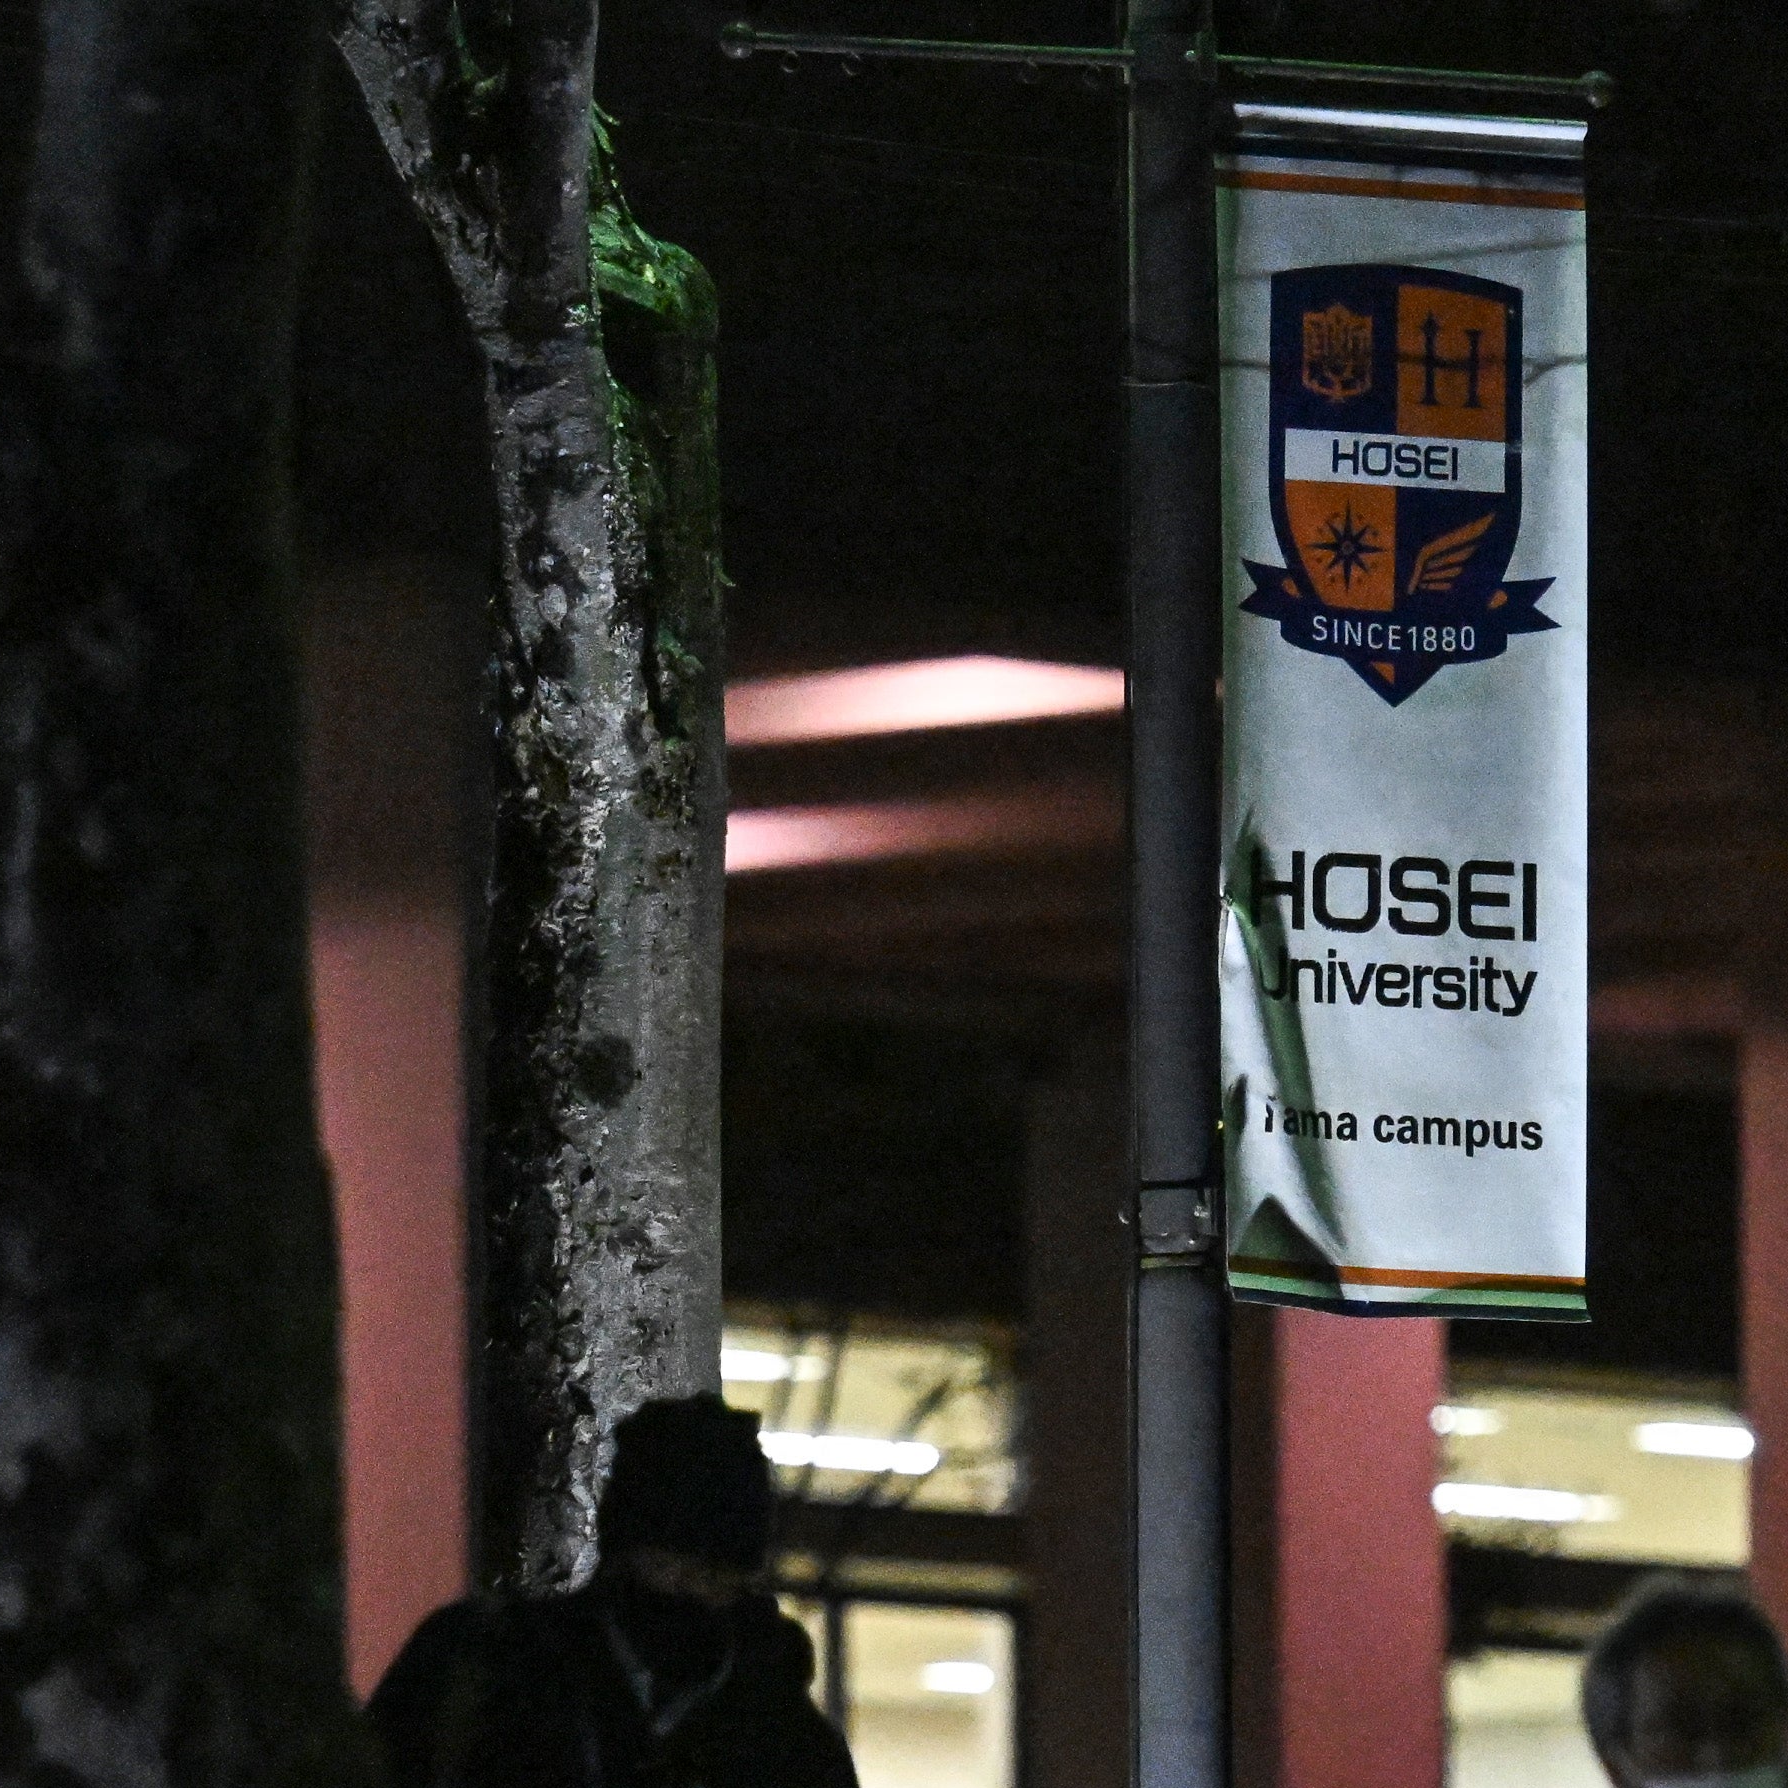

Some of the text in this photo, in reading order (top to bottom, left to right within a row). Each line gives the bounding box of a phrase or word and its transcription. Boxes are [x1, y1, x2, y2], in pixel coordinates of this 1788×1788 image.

[1331, 438, 1459, 481] HOSEI
[1251, 848, 1538, 942] HOSEI
[1257, 945, 1539, 1018] University
[1373, 1113, 1544, 1158] campus
